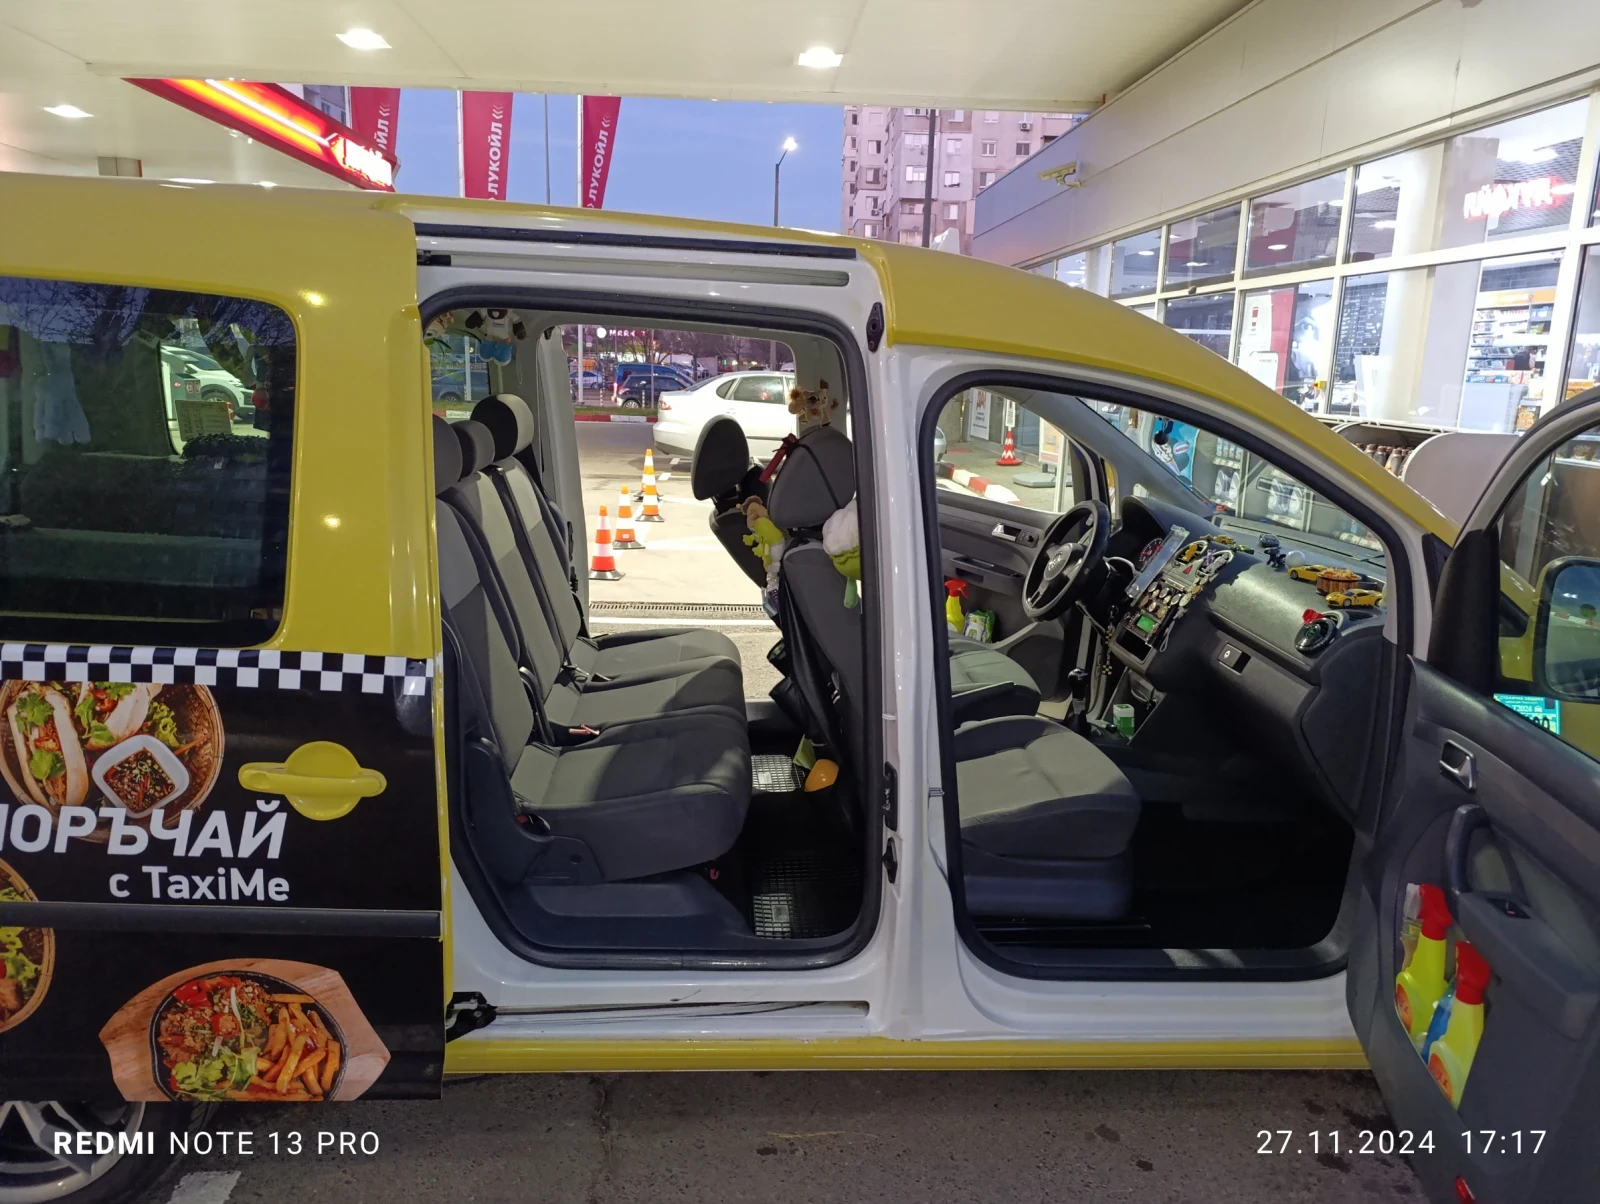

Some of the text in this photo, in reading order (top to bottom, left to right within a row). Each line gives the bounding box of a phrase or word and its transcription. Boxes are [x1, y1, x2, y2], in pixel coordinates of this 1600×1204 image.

[373, 118, 389, 151] ЙЛ
[487, 121, 503, 196] ЛУКОЙЛ
[588, 129, 609, 202] ЛУКОЙЛ
[142, 866, 290, 902] TaxiMe
